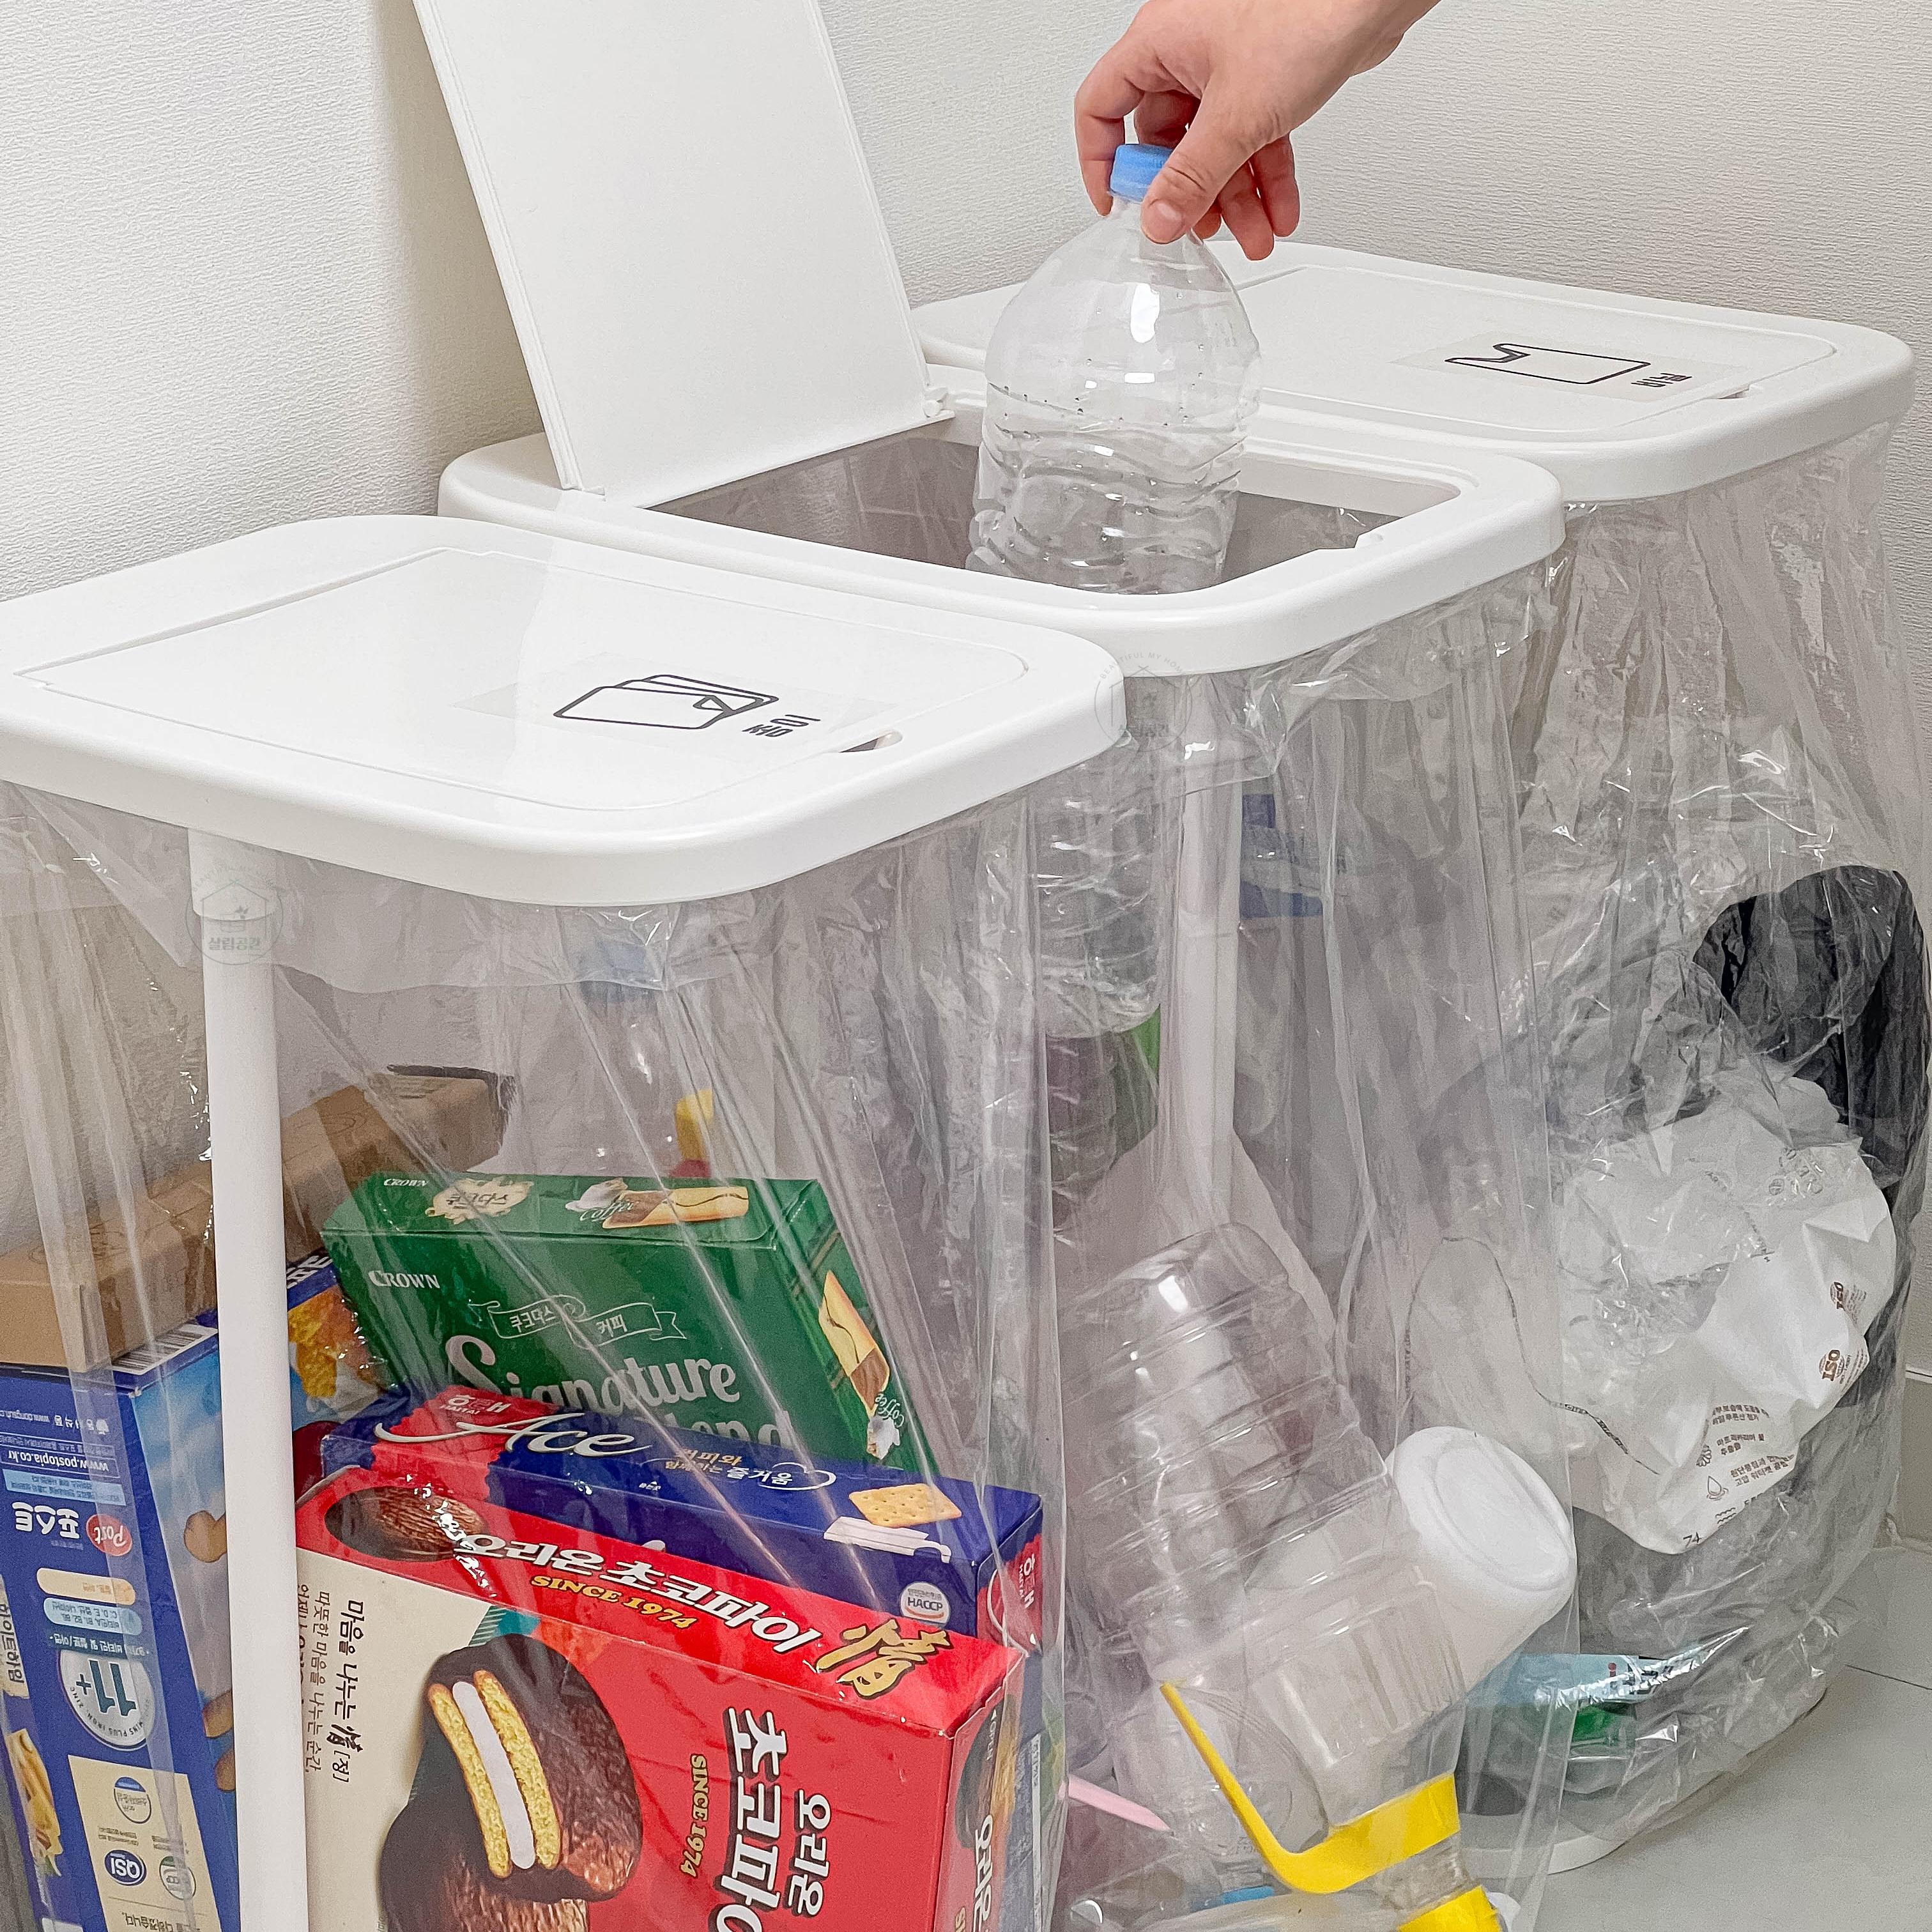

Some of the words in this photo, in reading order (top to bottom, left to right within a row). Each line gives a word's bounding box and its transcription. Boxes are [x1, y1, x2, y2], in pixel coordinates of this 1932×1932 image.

[1630, 372, 1693, 388] 비닐
[742, 713, 821, 738] 종이
[383, 1177, 429, 1188] CROWN
[509, 1305, 557, 1333] 쿠크다스
[595, 1314, 629, 1340] 커피
[1821, 1349, 1841, 1382] ISO
[875, 1393, 905, 1429] Coffee
[374, 1413, 652, 1457] Ace
[8, 1450, 110, 1473] www.postopia.co.kr
[726, 1466, 793, 1486] 즐거움
[12, 1501, 80, 1540] 포스트
[93, 1524, 128, 1548] Post
[453, 1533, 604, 1575] 오리온
[598, 1560, 823, 1654] 초코파이
[530, 1574, 622, 1604] SINCE
[623, 1596, 701, 1630] 1974
[907, 1597, 944, 1612] HACCP
[312, 1590, 331, 1638] 따뜻한
[338, 1598, 365, 1656] 마음을
[99, 1640, 123, 1654] 비타민
[309, 1641, 328, 1686] 마음을
[70, 1686, 84, 1708] ZINC
[75, 1659, 137, 1717] 11+
[334, 1662, 359, 1721] 나누는
[307, 1692, 325, 1735] 나누는
[108, 1728, 128, 1737] PLUS
[985, 1720, 997, 1762] OPEN
[690, 1753, 710, 1823] SINCE
[110, 1857, 141, 1879] QSI
[679, 1823, 707, 1878] 1974
[788, 1788, 831, 1915] 오리온
